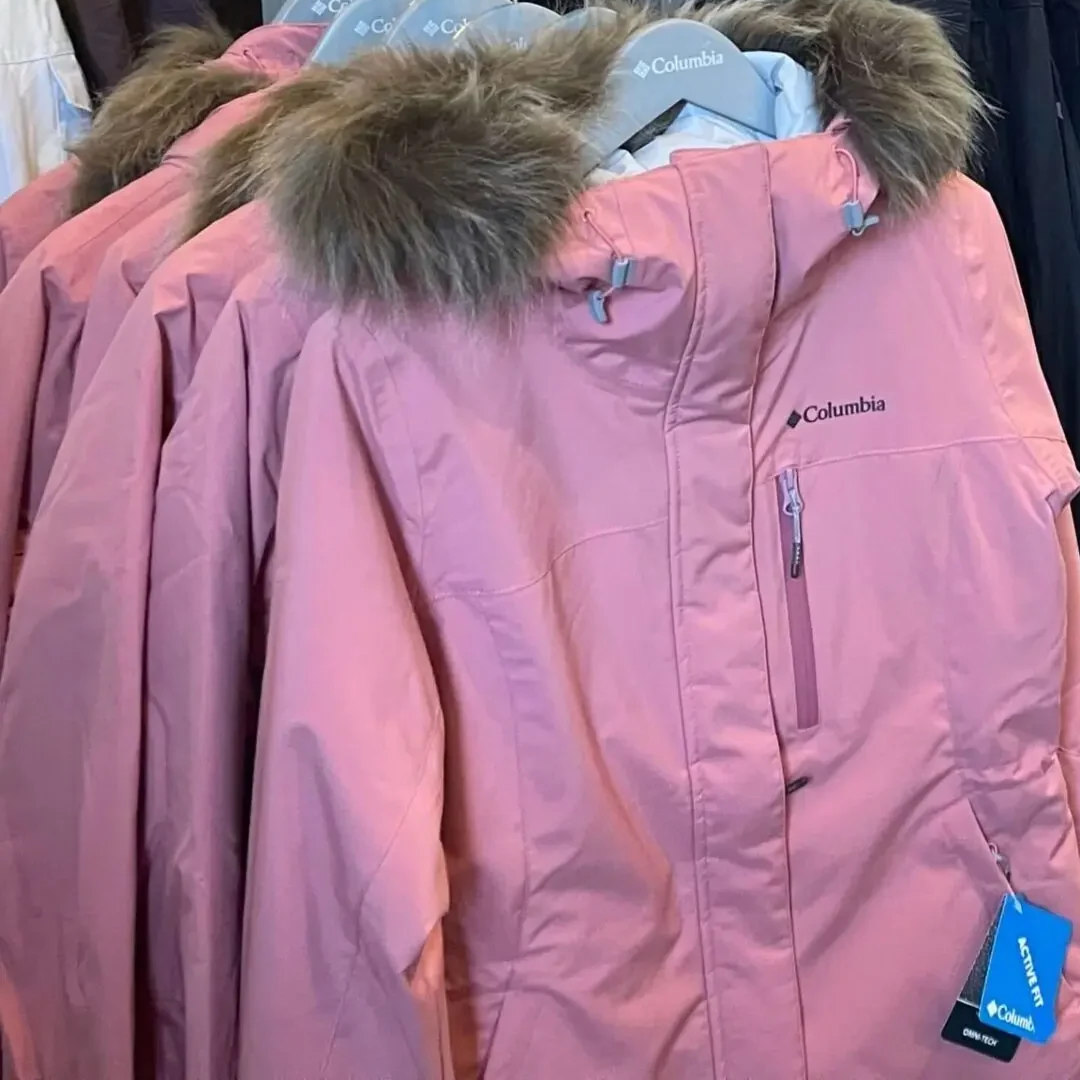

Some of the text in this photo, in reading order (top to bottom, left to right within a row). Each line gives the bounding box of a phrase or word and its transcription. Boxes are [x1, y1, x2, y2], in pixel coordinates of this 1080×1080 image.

[651, 50, 724, 75] Columbia
[803, 395, 886, 423] Columbia
[1017, 936, 1044, 1008] ACTIVE FIT
